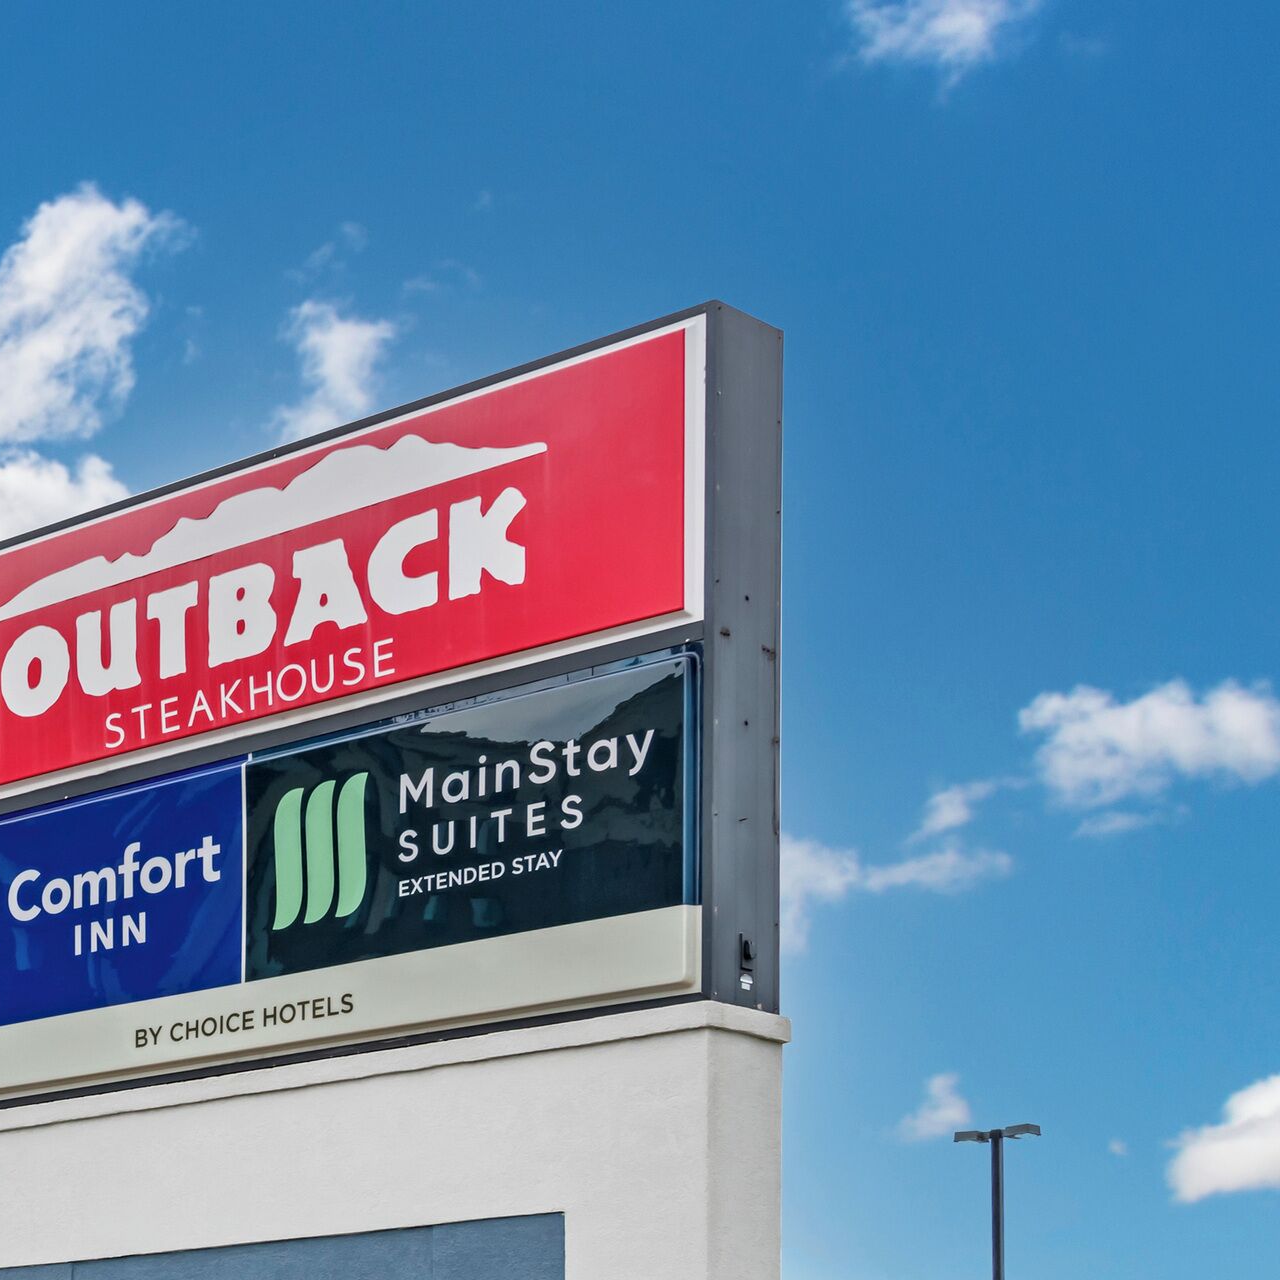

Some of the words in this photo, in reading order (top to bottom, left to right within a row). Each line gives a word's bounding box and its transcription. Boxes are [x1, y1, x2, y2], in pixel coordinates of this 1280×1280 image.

[1, 487, 526, 717] OUTBACK
[104, 637, 396, 749] STEAKHOUSE
[399, 730, 654, 814] MainStay
[398, 795, 583, 862] SUITES
[8, 835, 221, 921] Comfort
[398, 861, 505, 897] EXTENDED
[512, 850, 563, 874] STAY
[74, 912, 147, 956] INN
[135, 1026, 162, 1048] BY
[170, 1010, 255, 1042] CHOICE
[263, 993, 354, 1027] HOTELS
